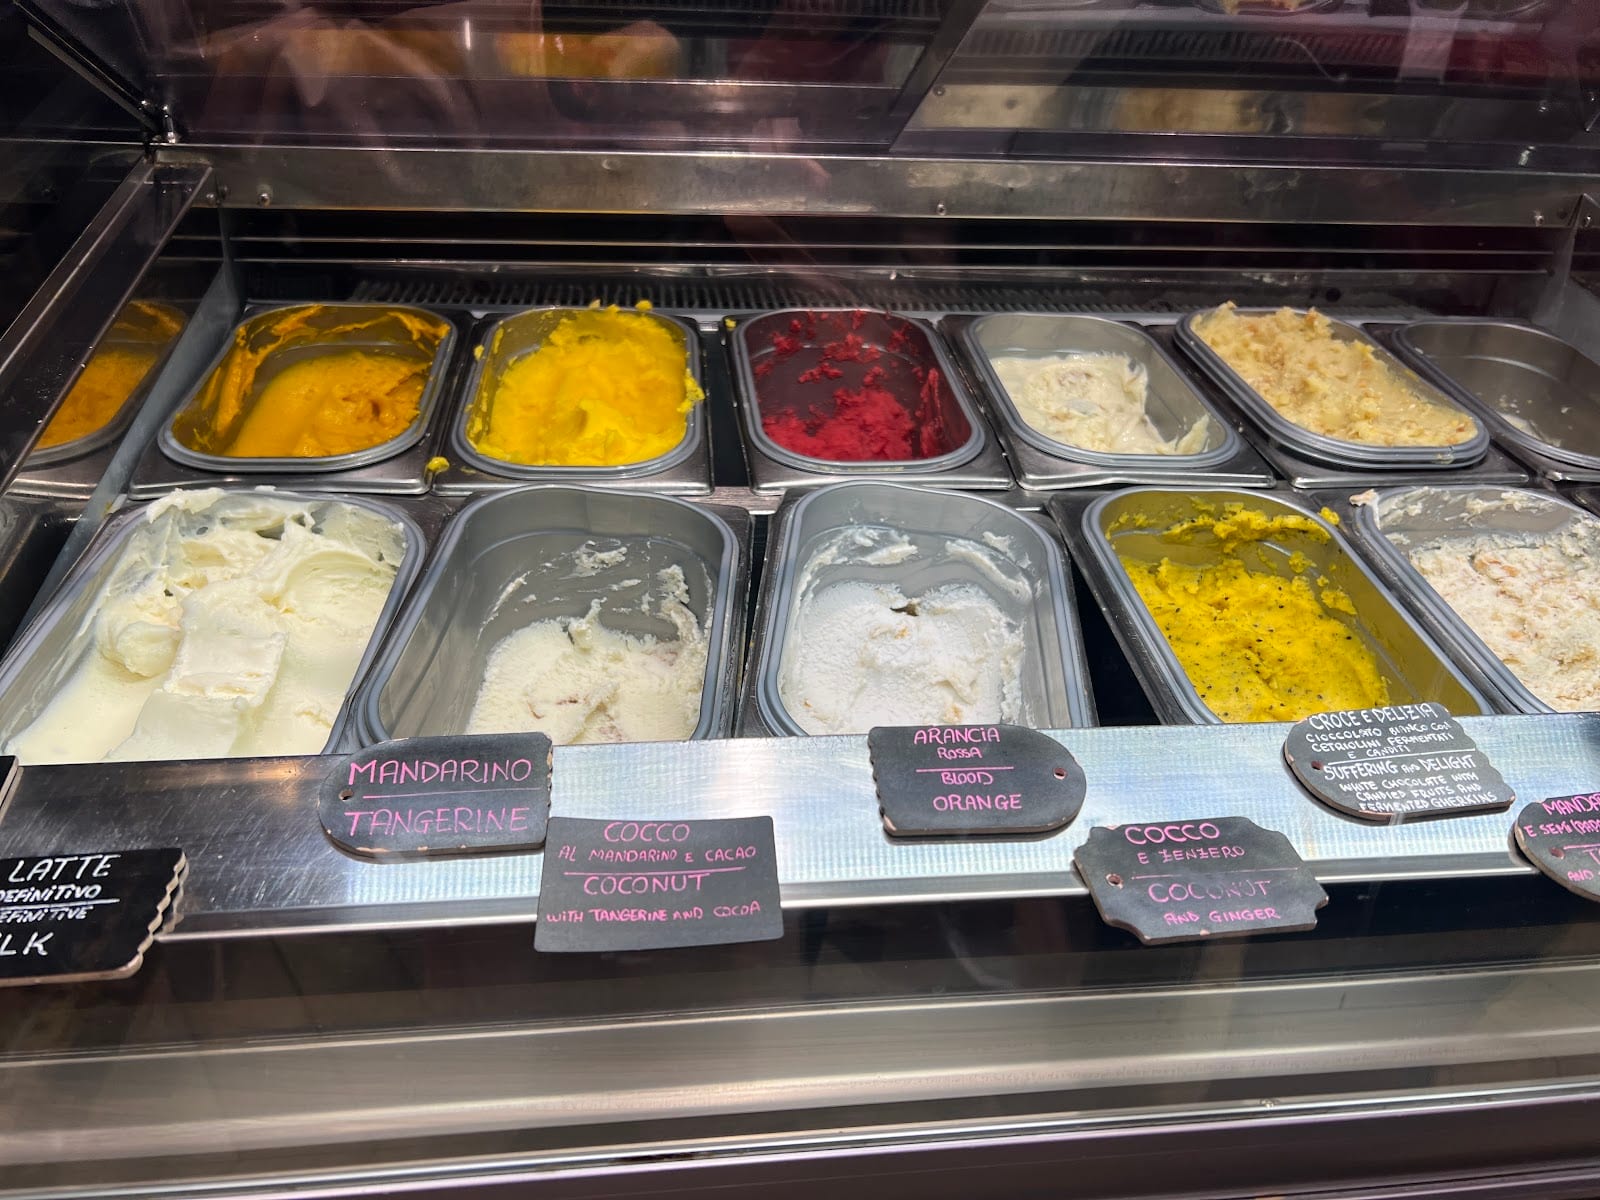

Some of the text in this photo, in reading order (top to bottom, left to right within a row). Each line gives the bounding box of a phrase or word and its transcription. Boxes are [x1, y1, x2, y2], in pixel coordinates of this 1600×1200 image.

[1308, 702, 1439, 731] CROCE E DELIZIA
[914, 725, 1001, 745] ARANCIA
[936, 746, 983, 760] ROSSA
[1347, 750, 1357, 760] E
[348, 758, 532, 785] MANDARINO
[1323, 759, 1399, 782] SUFFERING
[1417, 753, 1478, 773] DELIGHT
[941, 771, 994, 785] BLOOD
[1338, 779, 1379, 793] WHITE
[1381, 774, 1448, 790] CHOCOLATE
[1409, 784, 1455, 799] FRUITS
[1430, 790, 1498, 810] GHERKINS
[932, 793, 1023, 811] ORANGE
[344, 807, 530, 837] TANGERINE
[603, 821, 691, 843] COCCO
[1523, 824, 1537, 838] E
[1124, 822, 1221, 845] COCCO
[557, 845, 757, 863] AL MANDARINO E CACAO
[1137, 845, 1246, 864] E ZENZERO
[8, 854, 121, 883] LATTE
[1566, 868, 1595, 882] AND
[583, 872, 712, 895] COCONUT
[1148, 878, 1272, 903] COCONUT
[588, 906, 668, 923] TANGERINE
[672, 905, 704, 921] AND
[713, 900, 761, 918] COCOA
[1163, 906, 1282, 926] AND GINGER
[0, 931, 54, 956] LK
